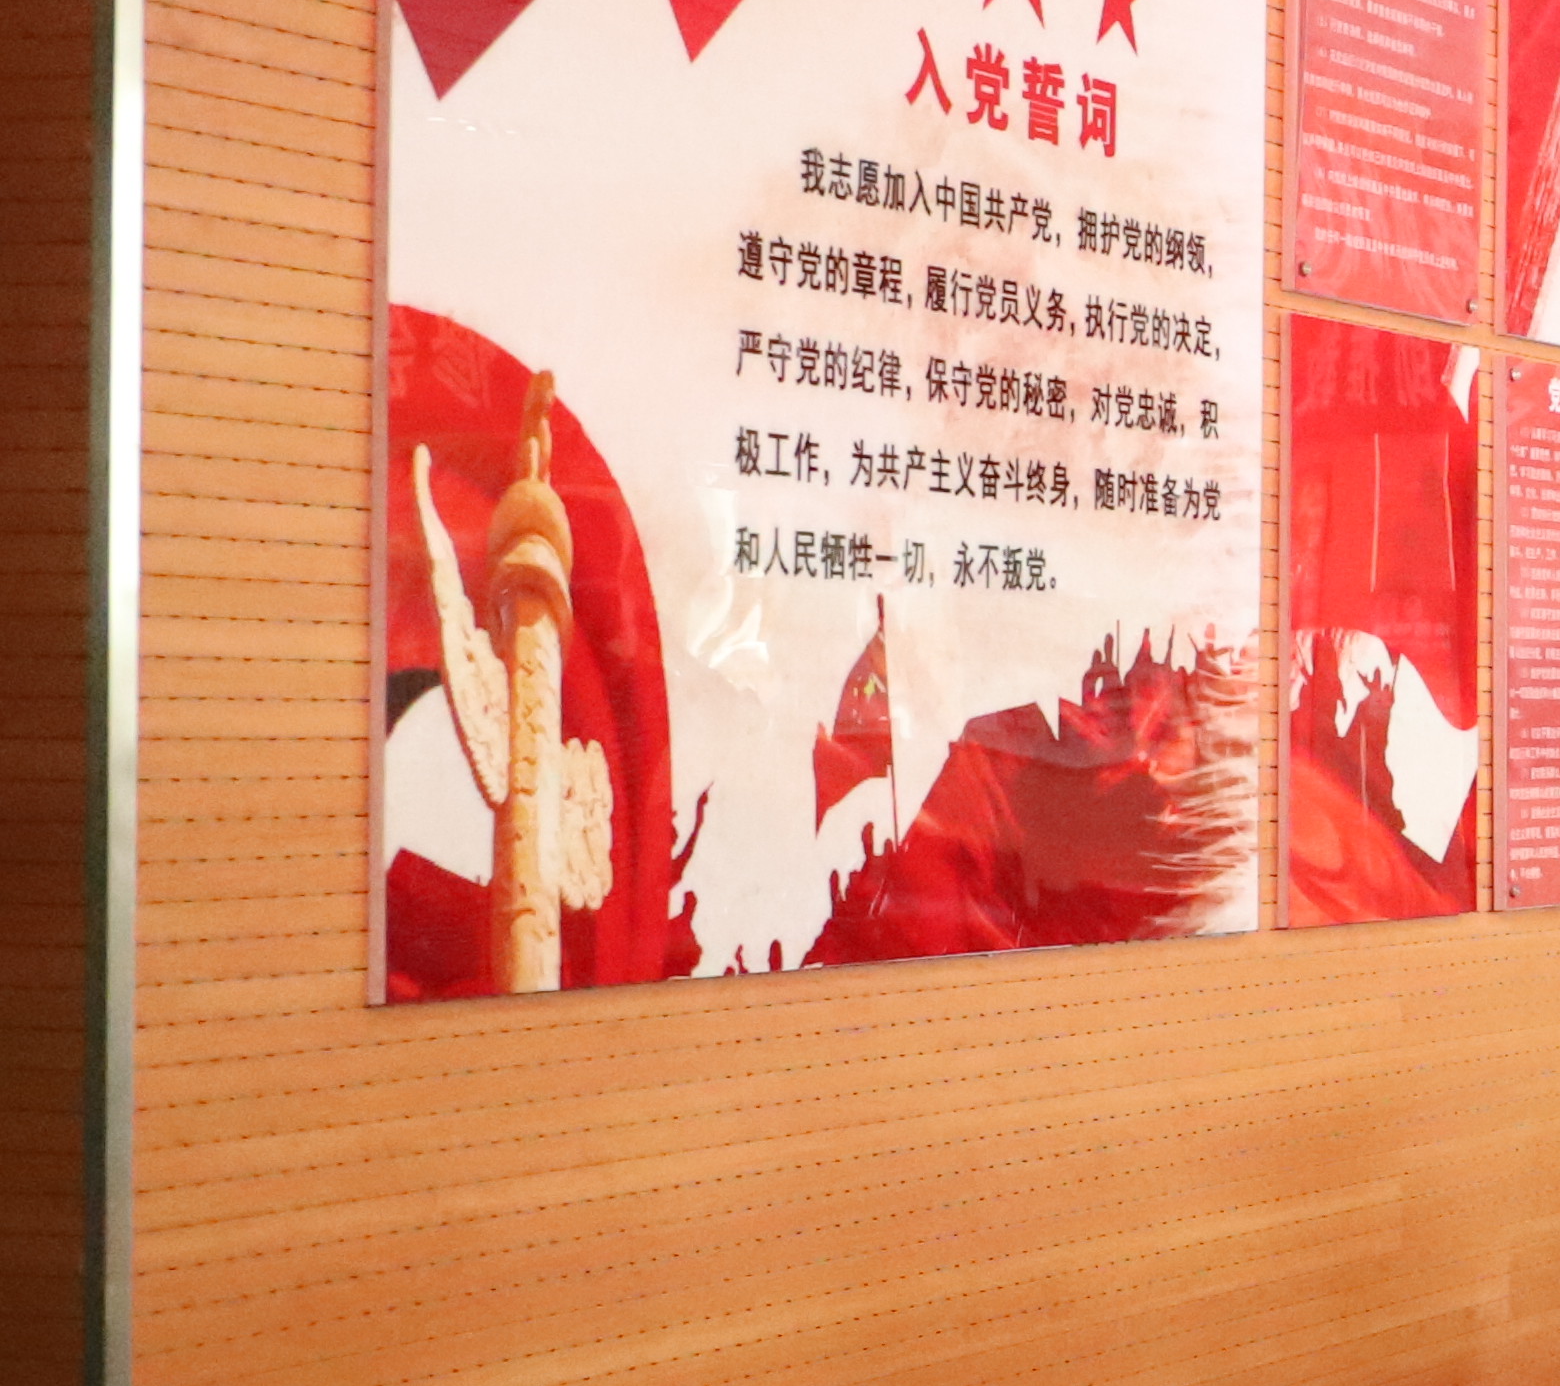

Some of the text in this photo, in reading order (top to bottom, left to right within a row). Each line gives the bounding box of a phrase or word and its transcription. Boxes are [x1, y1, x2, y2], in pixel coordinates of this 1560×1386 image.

[905, 28, 1116, 157] 入党誓词
[734, 527, 1058, 592] 和人民牺牲一切，永不叛党。
